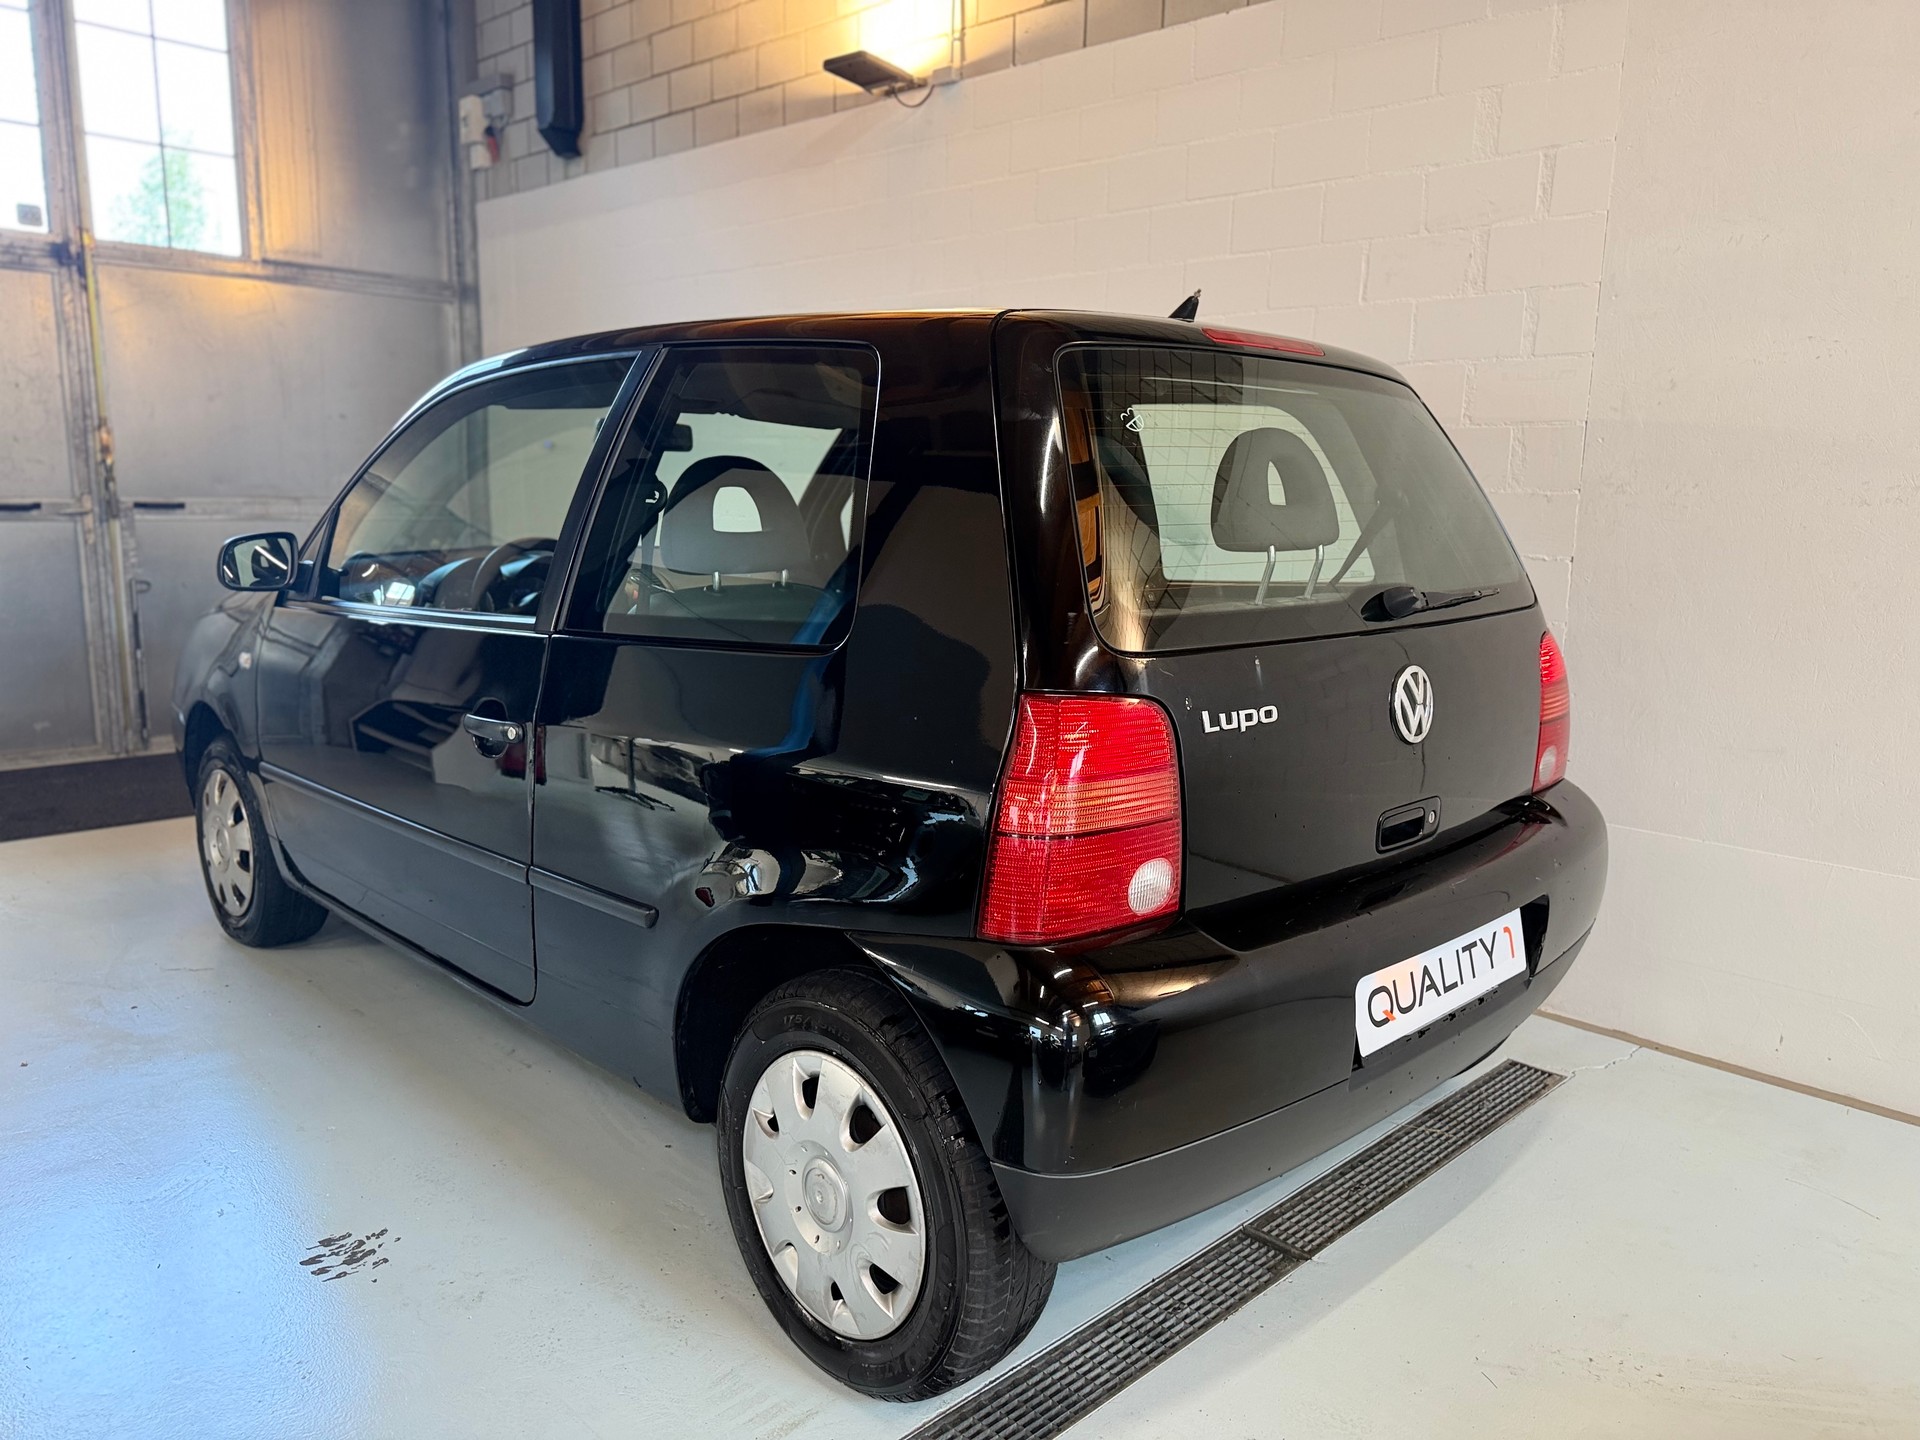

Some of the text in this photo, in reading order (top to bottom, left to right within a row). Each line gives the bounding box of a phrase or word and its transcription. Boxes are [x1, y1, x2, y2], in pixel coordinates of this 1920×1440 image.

[1201, 705, 1278, 733] Lupo
[1367, 926, 1515, 1028] QUALITY 1
